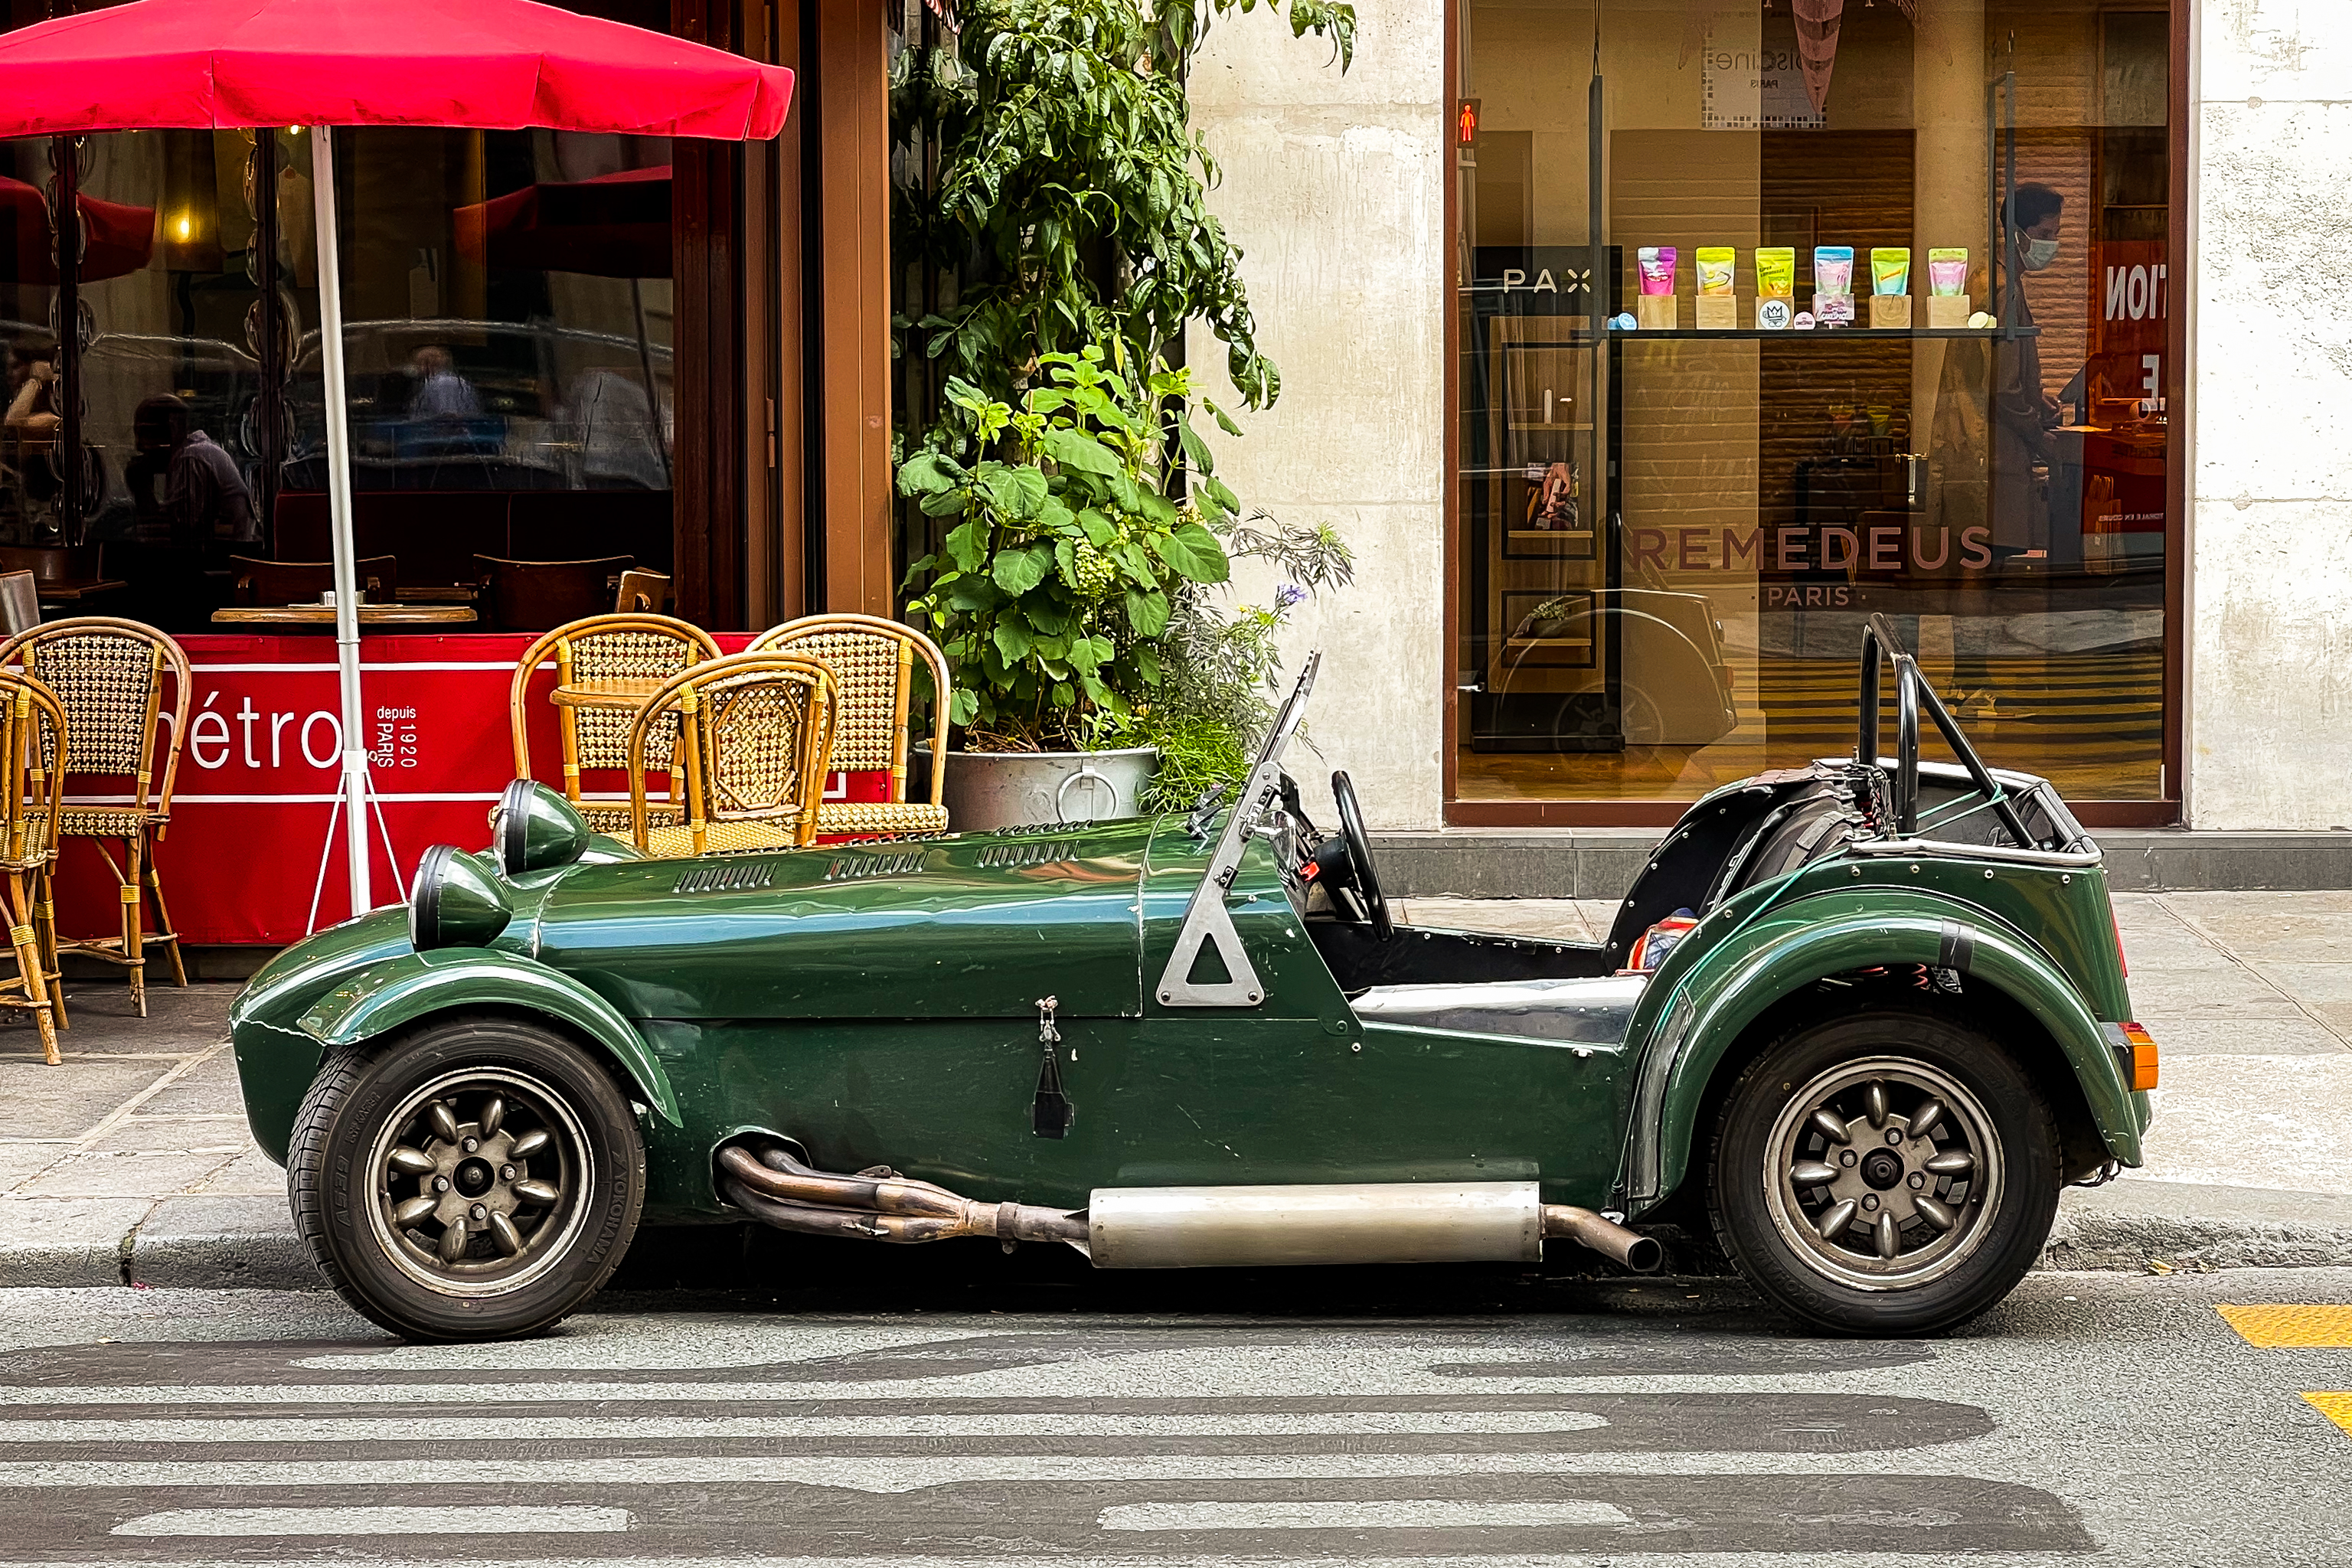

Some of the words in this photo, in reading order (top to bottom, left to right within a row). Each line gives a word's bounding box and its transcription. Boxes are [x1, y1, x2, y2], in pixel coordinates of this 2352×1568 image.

[1504, 268, 1590, 293] PAX
[1632, 526, 1991, 570] REMEDEUS
[1767, 586, 1850, 607] PARIS
[377, 705, 416, 722] depuis
[377, 723, 394, 768] PARIS
[400, 723, 417, 768] 1920
[586, 1170, 628, 1263] YOKOHAMA
